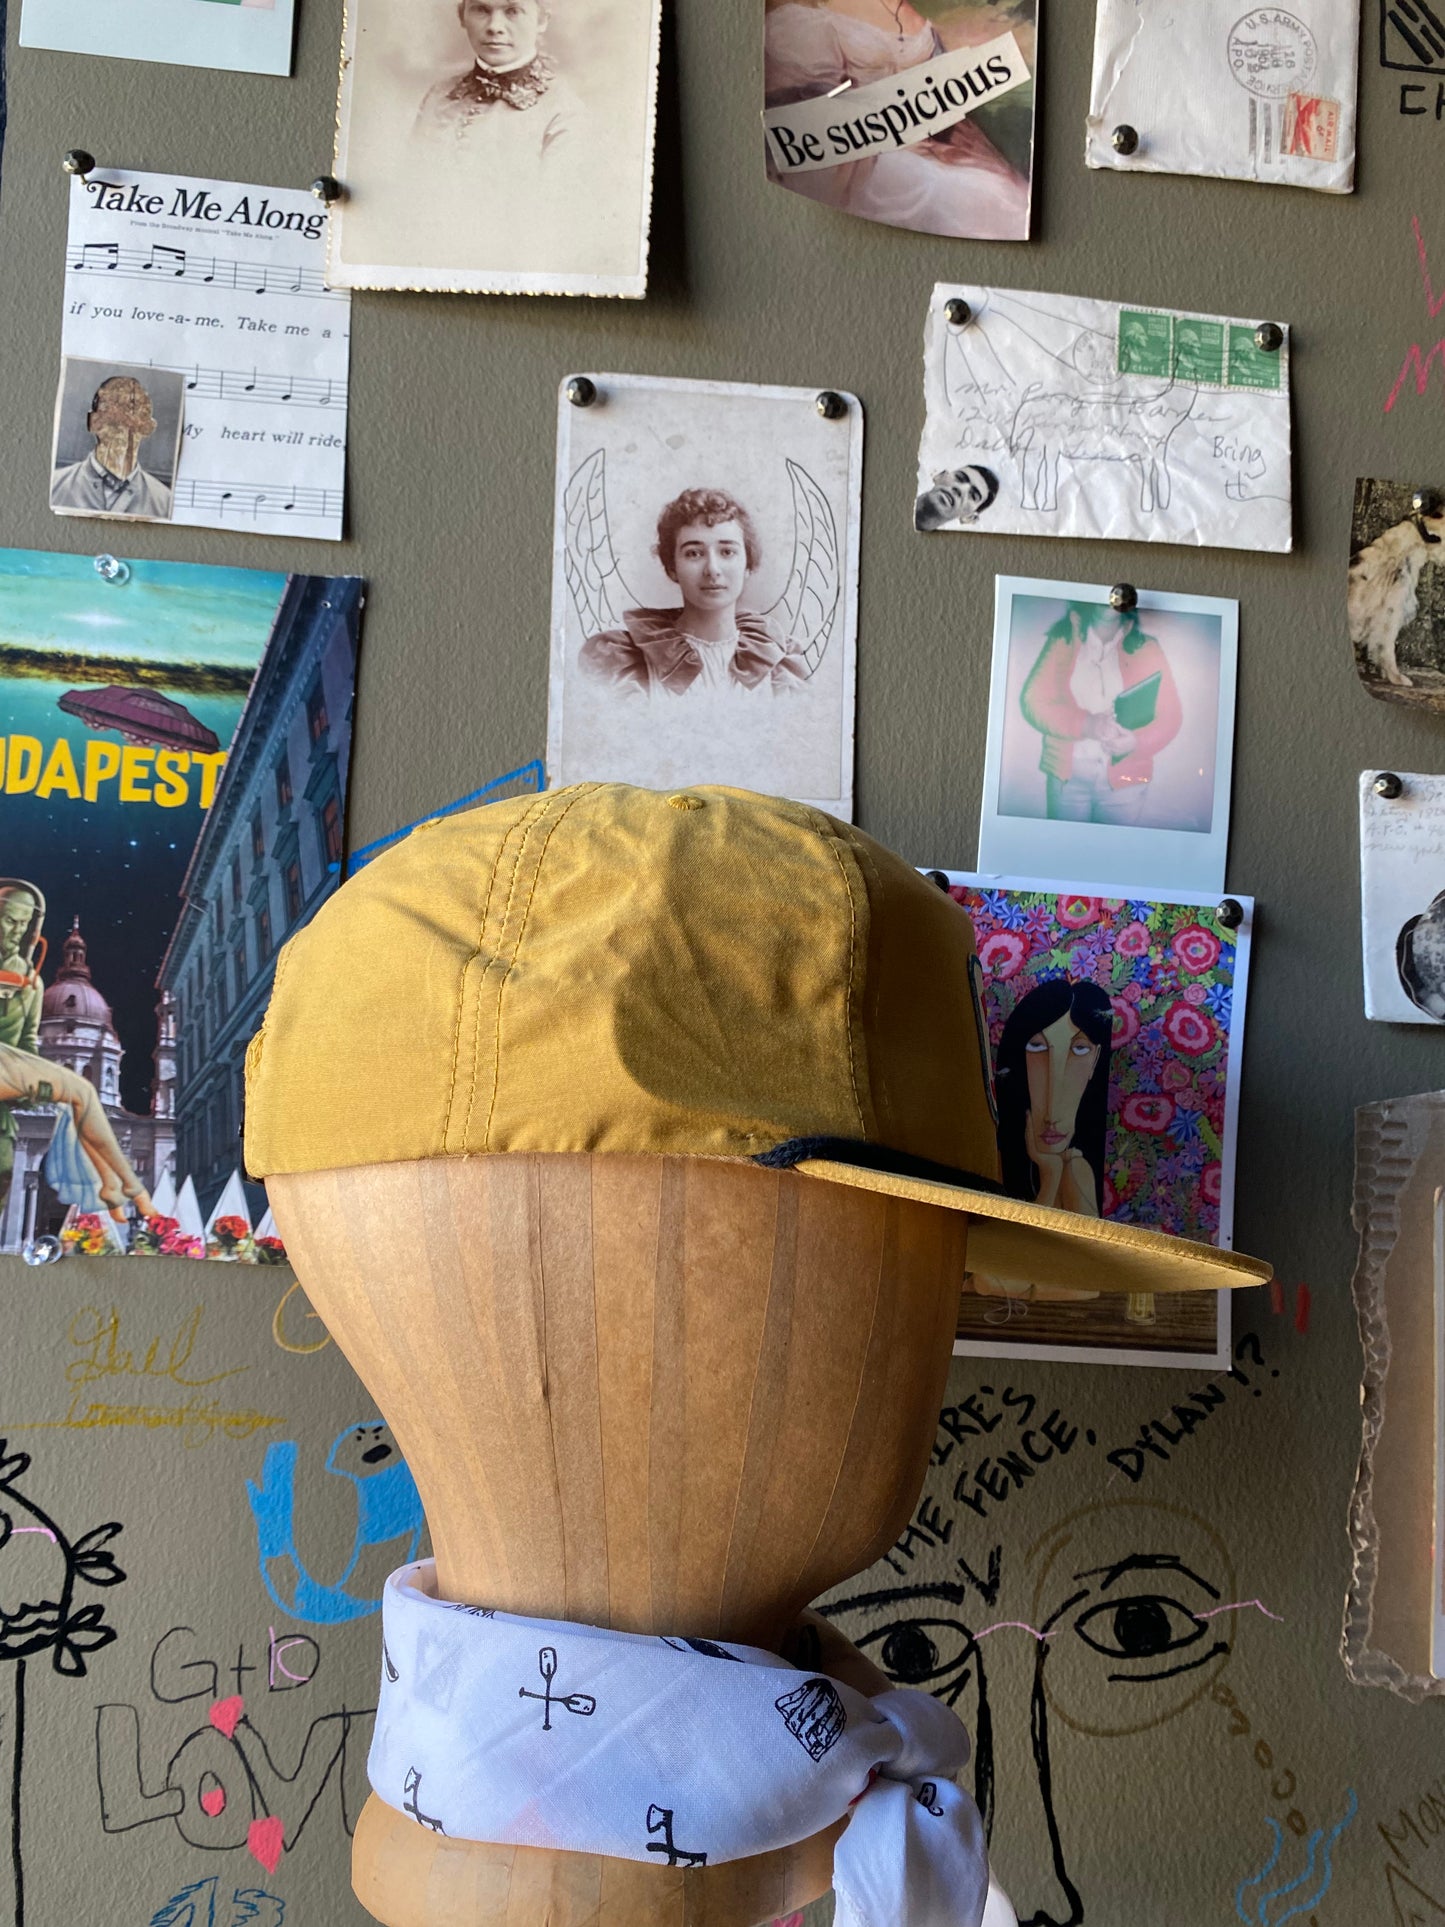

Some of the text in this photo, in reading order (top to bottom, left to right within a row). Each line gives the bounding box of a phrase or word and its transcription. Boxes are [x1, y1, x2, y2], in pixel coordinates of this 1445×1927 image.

[770, 55, 1012, 167] Be suspicious
[86, 180, 328, 240] Take Me Along
[68, 301, 86, 315] if
[91, 305, 123, 320] you
[195, 315, 224, 329] me.
[237, 316, 278, 334] Take
[284, 325, 310, 337] me
[220, 426, 266, 443] heart
[272, 431, 304, 446] will
[1213, 435, 1267, 480] Bring
[0, 734, 230, 809] DAPEST
